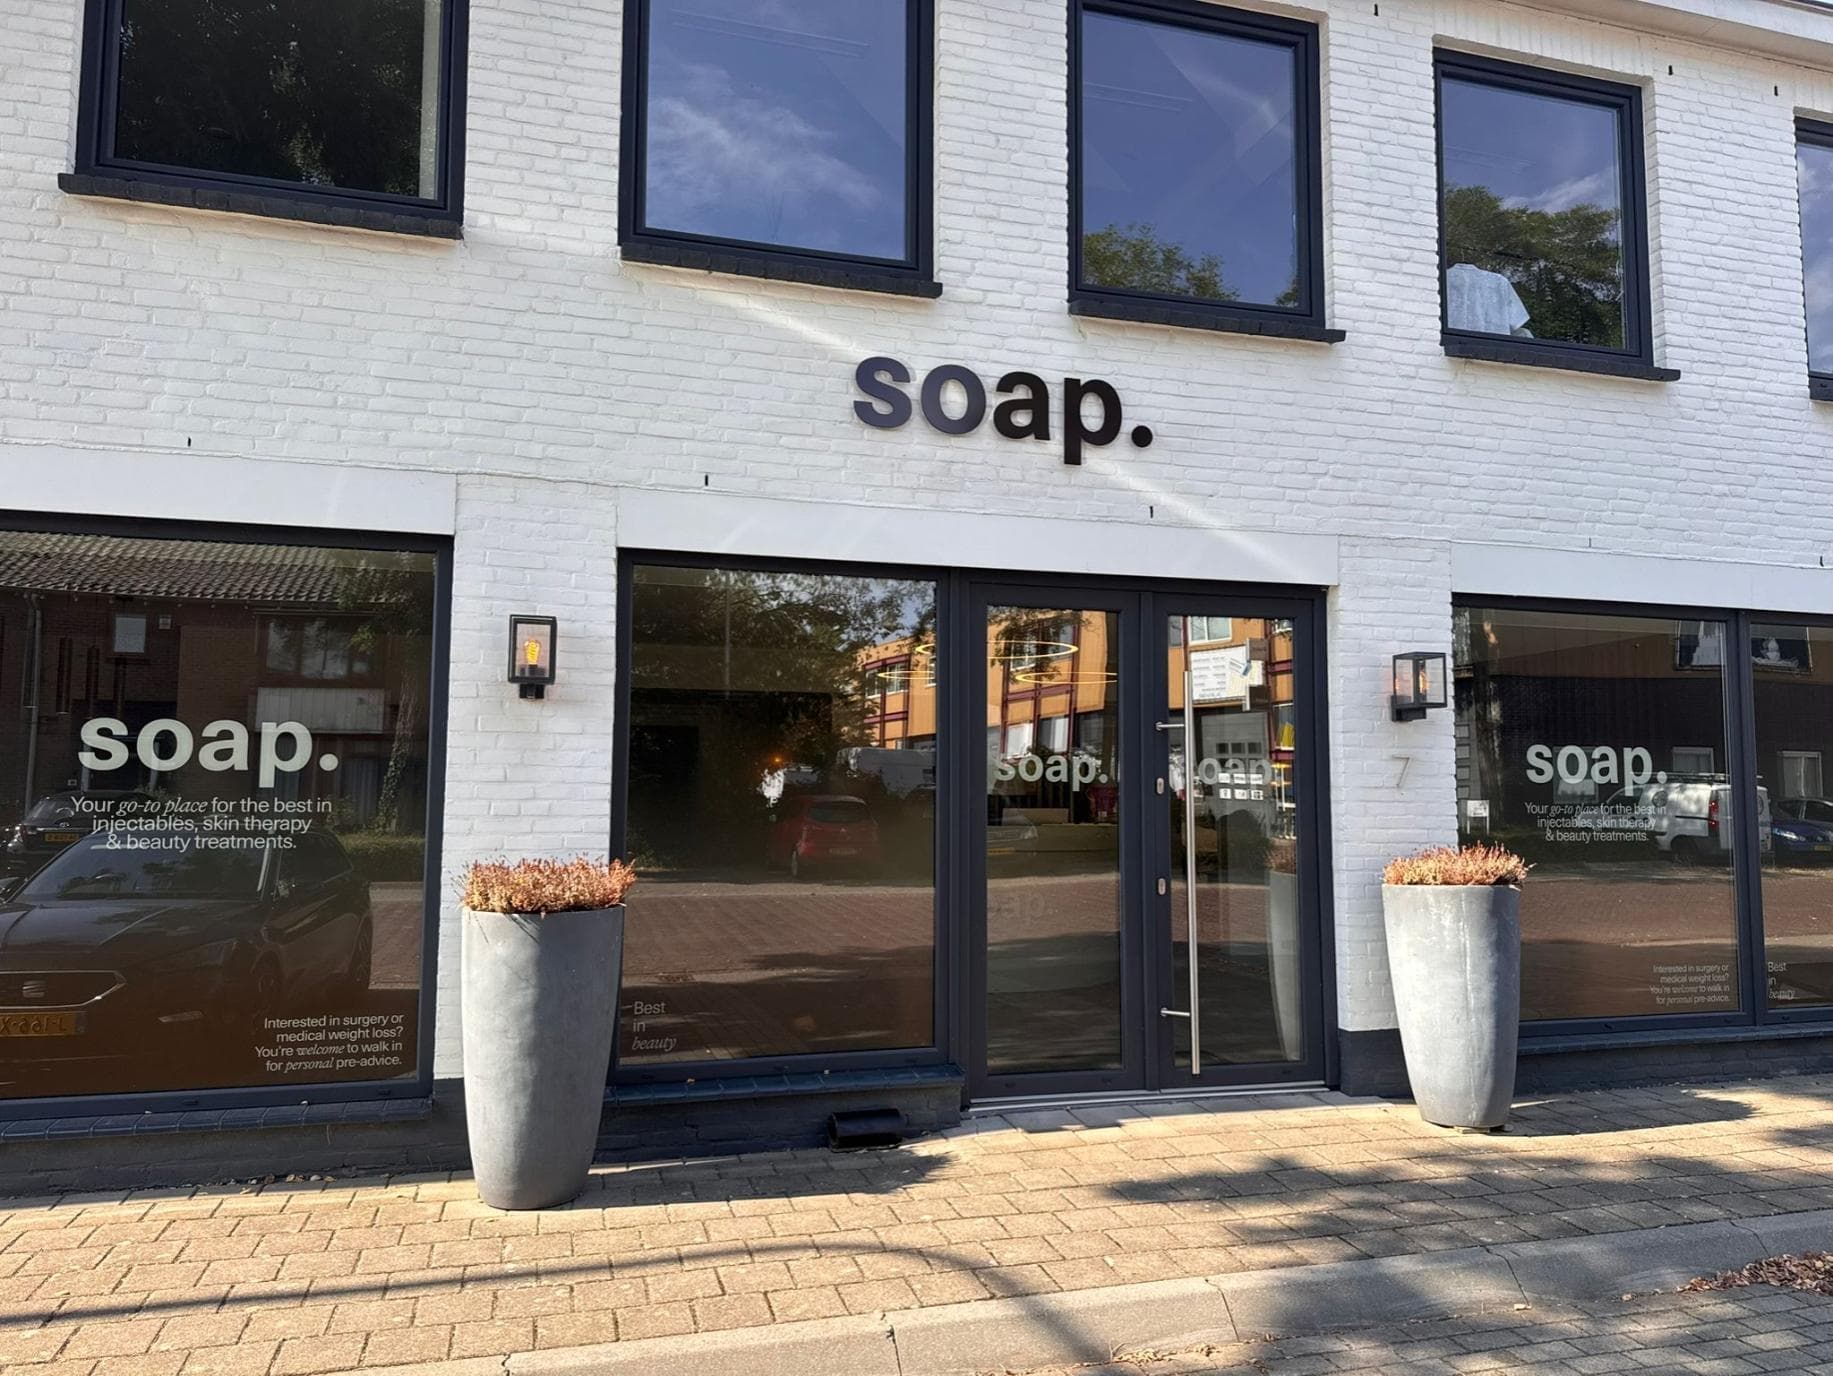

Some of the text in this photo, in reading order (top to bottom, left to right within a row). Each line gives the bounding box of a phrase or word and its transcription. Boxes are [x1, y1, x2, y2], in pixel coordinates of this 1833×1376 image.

[853, 356, 1153, 466] soap.
[78, 717, 339, 788] soap.
[995, 754, 1108, 792] soap.
[1392, 754, 1410, 788] 7
[1526, 744, 1668, 796] soap.
[71, 796, 332, 817] Your go-to place for the best in
[1525, 802, 1550, 814] Your
[1575, 803, 1599, 817] place
[1600, 802, 1614, 814] for
[1616, 803, 1632, 814] the
[1634, 803, 1656, 815] best
[1657, 804, 1667, 814] in
[92, 815, 312, 835] injectables, skin therapy
[1537, 816, 1656, 831] injectables, skin therapy
[106, 834, 297, 853] & beauty treatments.
[1545, 830, 1649, 844] & beauty treatments.
[1768, 961, 1787, 972] Best
[634, 1001, 667, 1015] Best
[264, 1014, 405, 1029] Interested in surgery or
[632, 1018, 646, 1032] in
[276, 1026, 403, 1042] medical weight loss?
[255, 1040, 403, 1057] You're welcome to walk in
[631, 1036, 678, 1052] beauty
[266, 1055, 402, 1073] for personal pre-advice.
